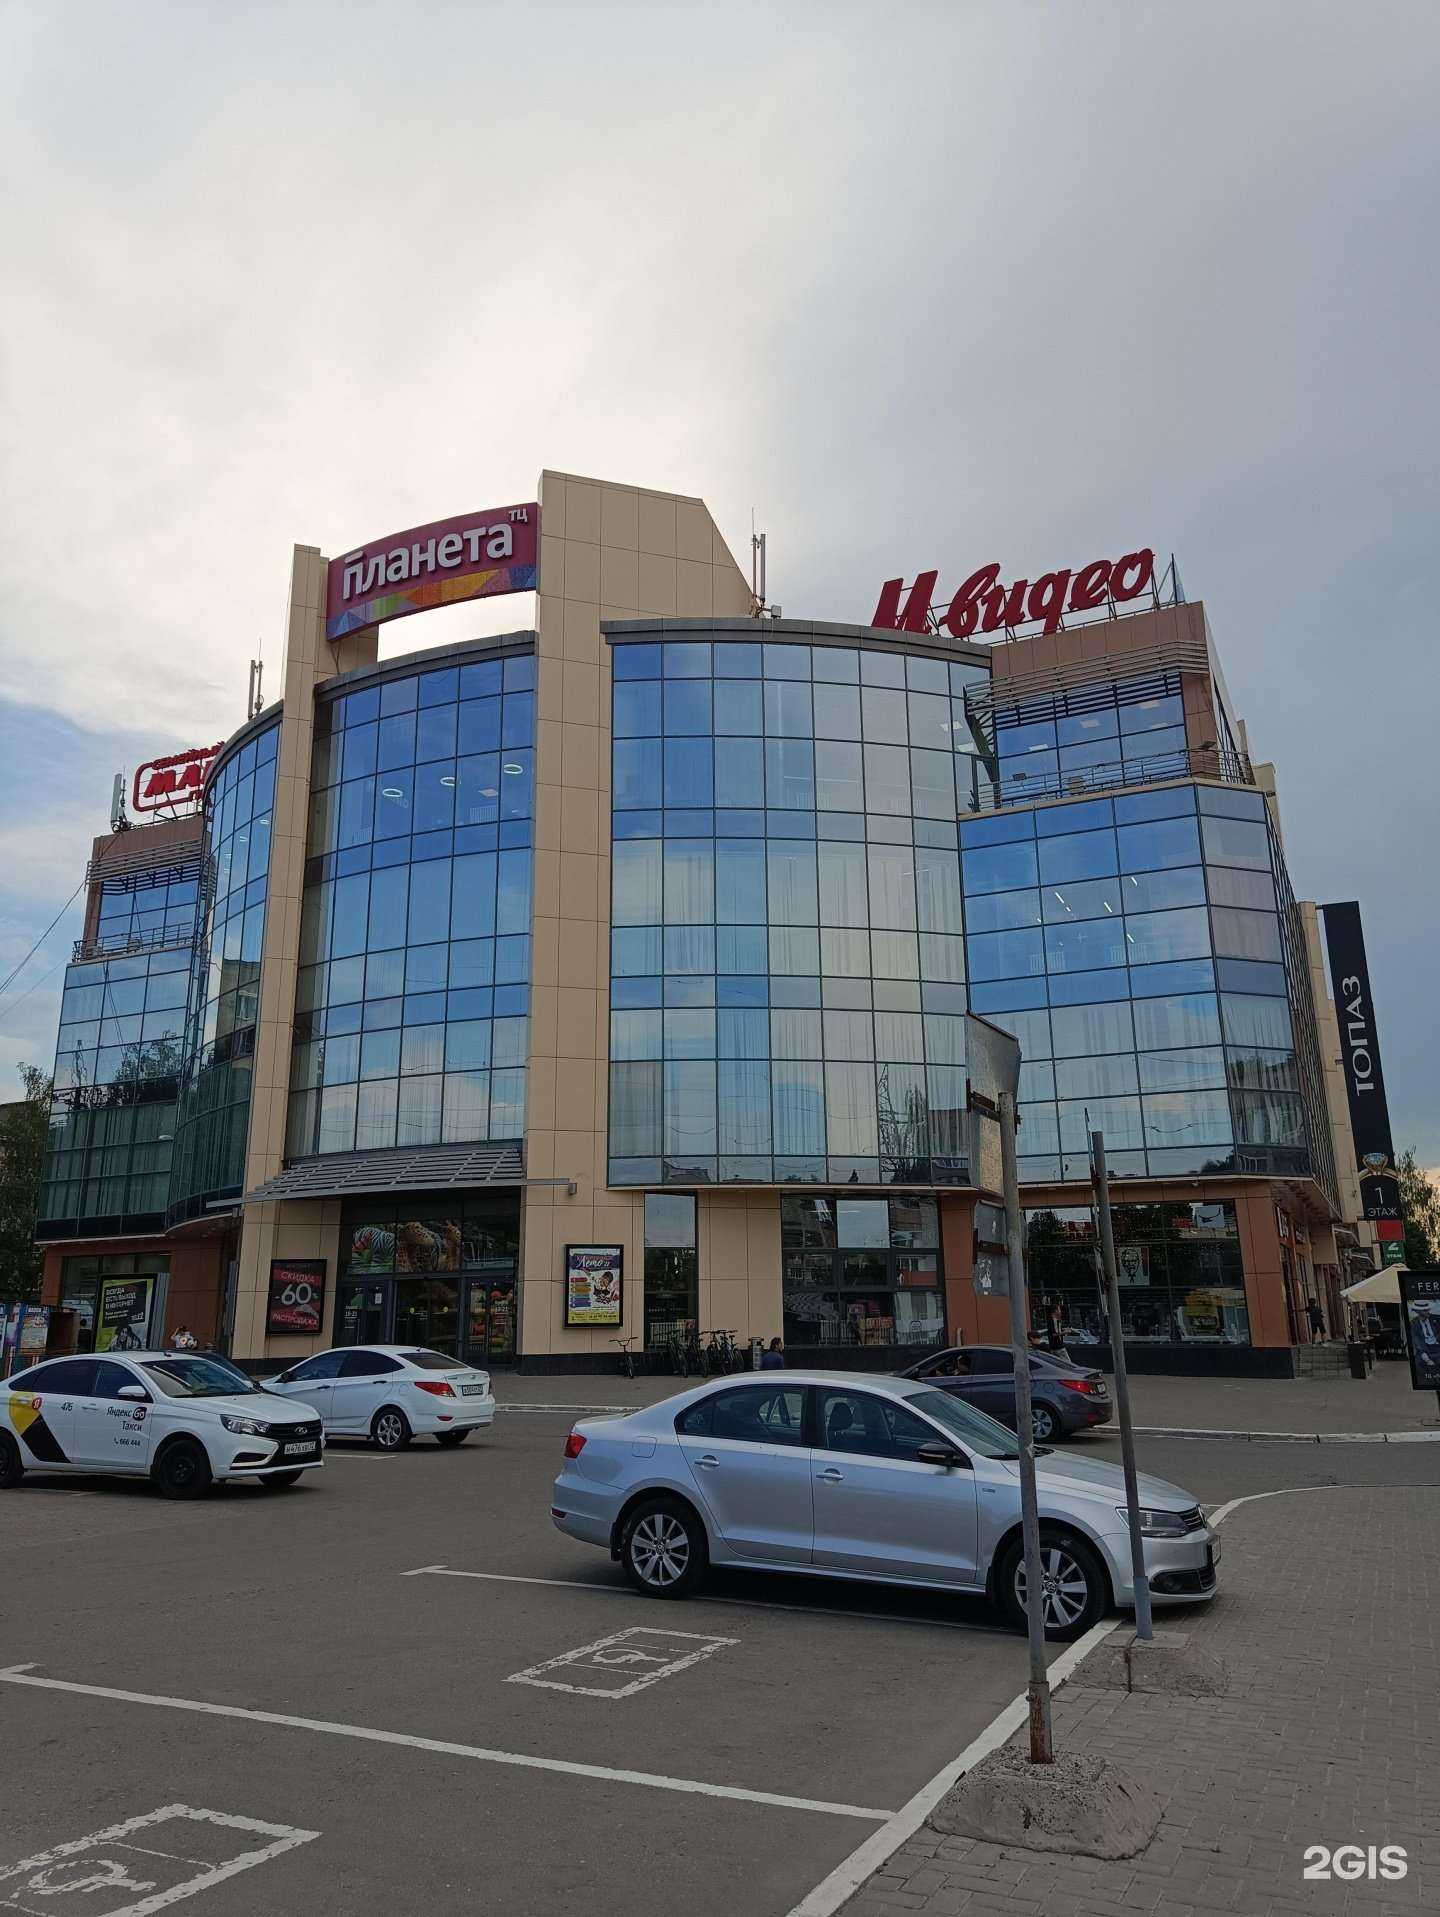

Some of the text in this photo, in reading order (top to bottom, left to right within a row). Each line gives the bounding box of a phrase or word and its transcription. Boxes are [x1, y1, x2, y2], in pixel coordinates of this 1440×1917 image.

[508, 508, 528, 522] ТЦ
[1342, 975, 1375, 1097] ТОПАЗ
[1375, 1187, 1384, 1205] 1
[1367, 1207, 1399, 1217] ЭТАЖ
[107, 1406, 146, 1419] Яндекс Go
[122, 1420, 143, 1432] Такси
